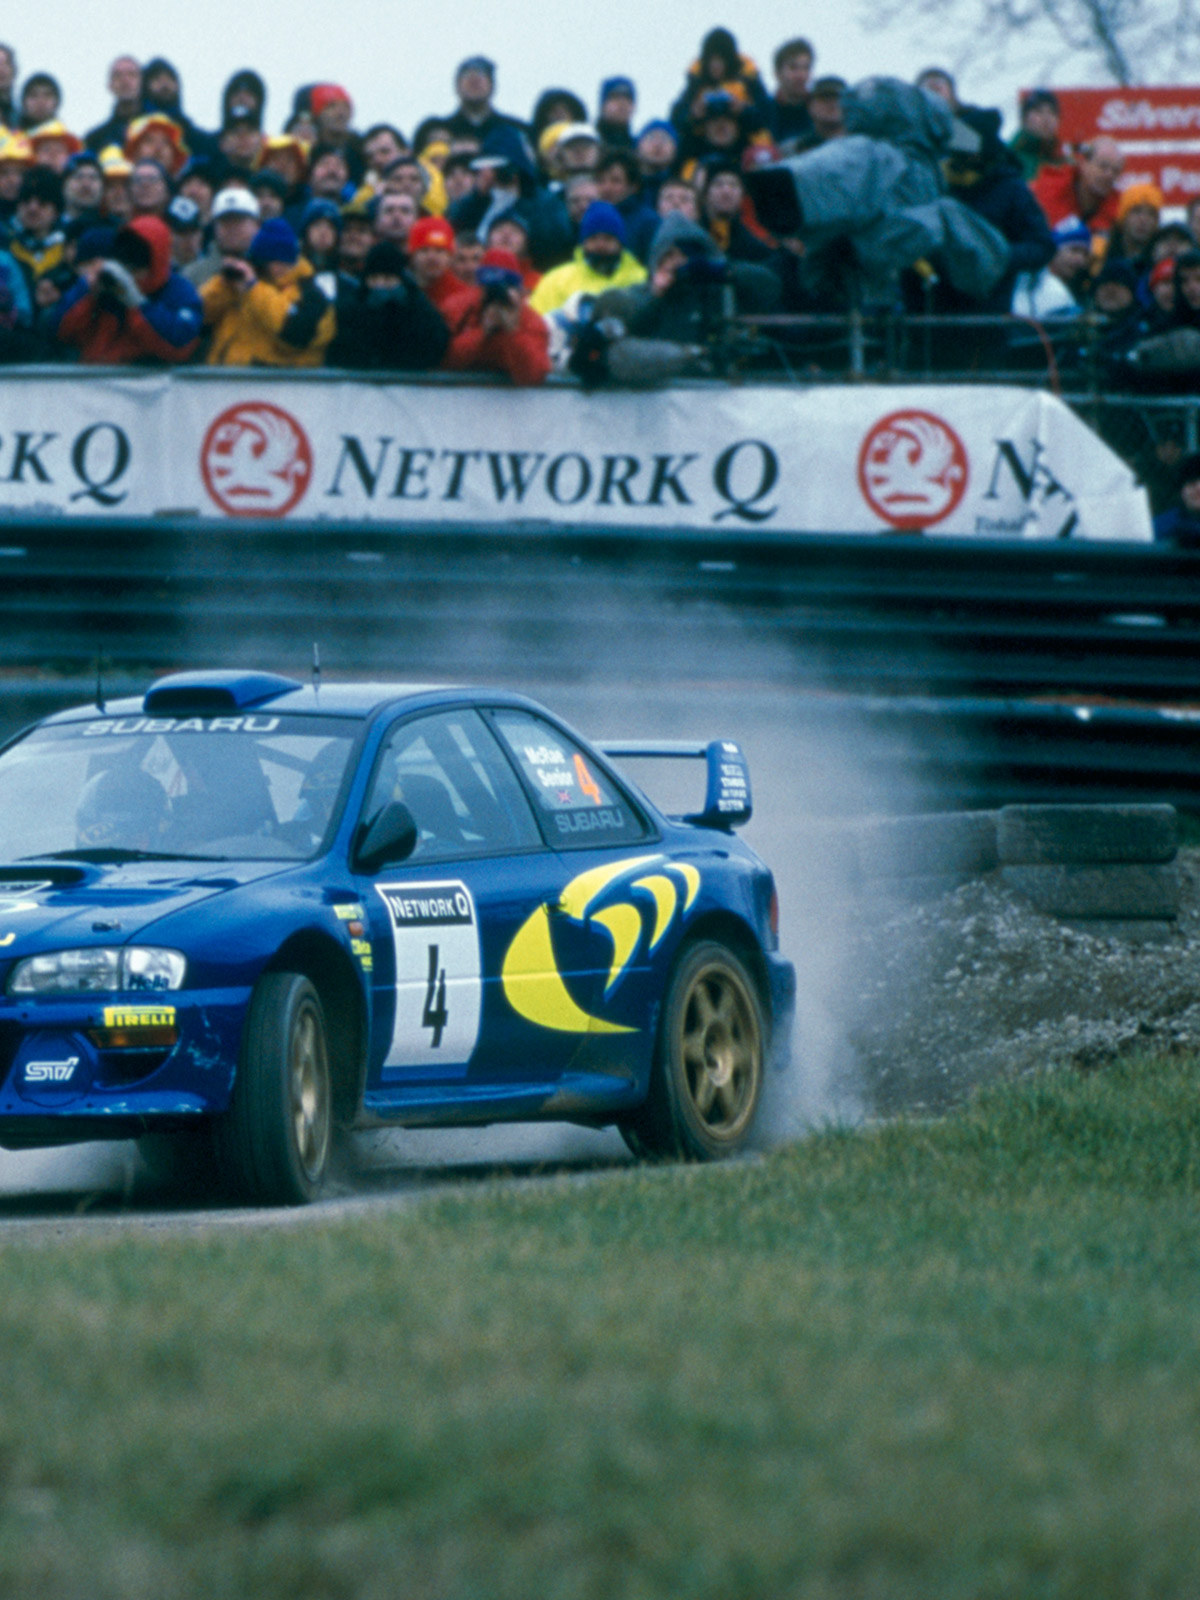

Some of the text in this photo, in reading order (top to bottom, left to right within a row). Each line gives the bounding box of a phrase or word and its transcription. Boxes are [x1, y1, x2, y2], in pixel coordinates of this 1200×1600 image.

[70, 420, 132, 506] Q
[711, 438, 781, 523] Q
[82, 716, 281, 736] SUBARU
[572, 753, 602, 806] 4
[555, 809, 625, 833] SUBARU
[455, 892, 470, 916] Q
[422, 943, 449, 1049] 4
[103, 1006, 176, 1027] PIRELLI
